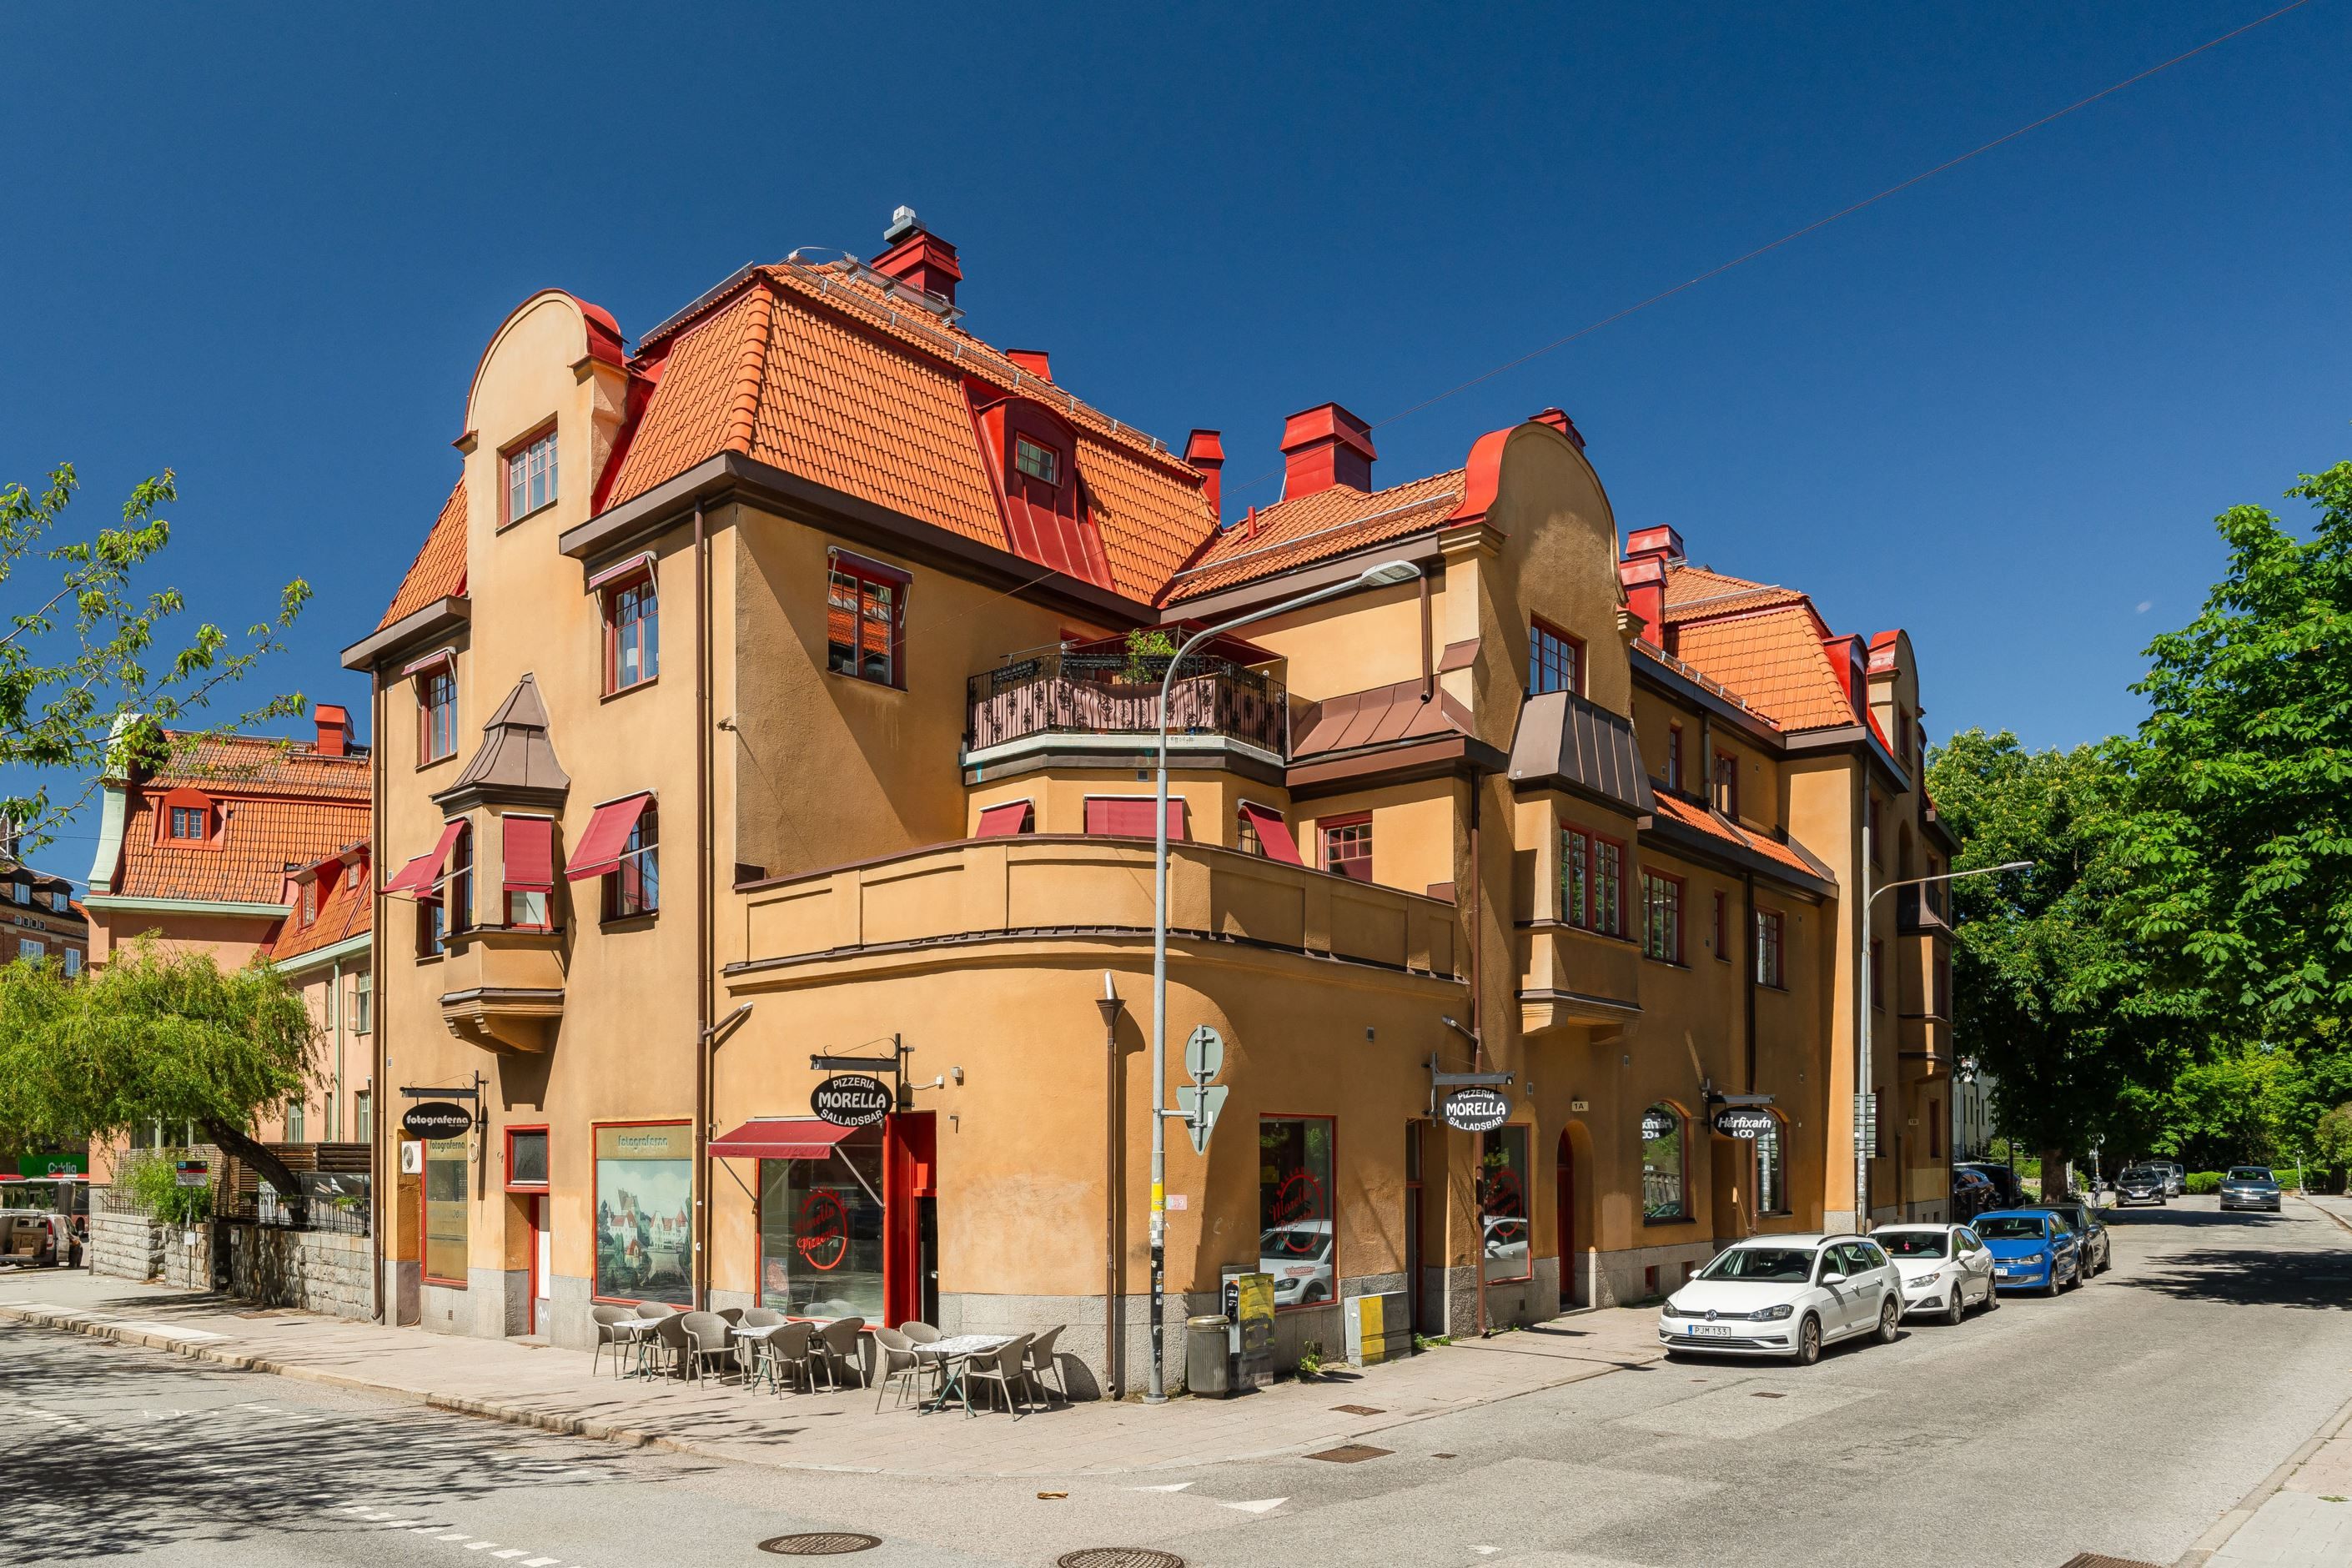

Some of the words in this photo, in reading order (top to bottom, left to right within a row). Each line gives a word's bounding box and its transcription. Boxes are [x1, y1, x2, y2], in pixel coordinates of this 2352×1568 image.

[832, 1077, 875, 1091] PIZZERIA
[818, 1092, 887, 1108] MORELLA
[1457, 1089, 1495, 1100] PIZZERIA
[1446, 1101, 1506, 1116] MORELLA
[406, 1114, 469, 1126] fotograferna
[820, 1108, 883, 1126] SALLADSBAR
[1448, 1116, 1504, 1131] SALLADSBAR
[430, 1139, 465, 1153] fotograferna
[618, 1134, 667, 1150] fotograferna
[1695, 1326, 1710, 1334] PJM
[1712, 1328, 1727, 1336] 133
